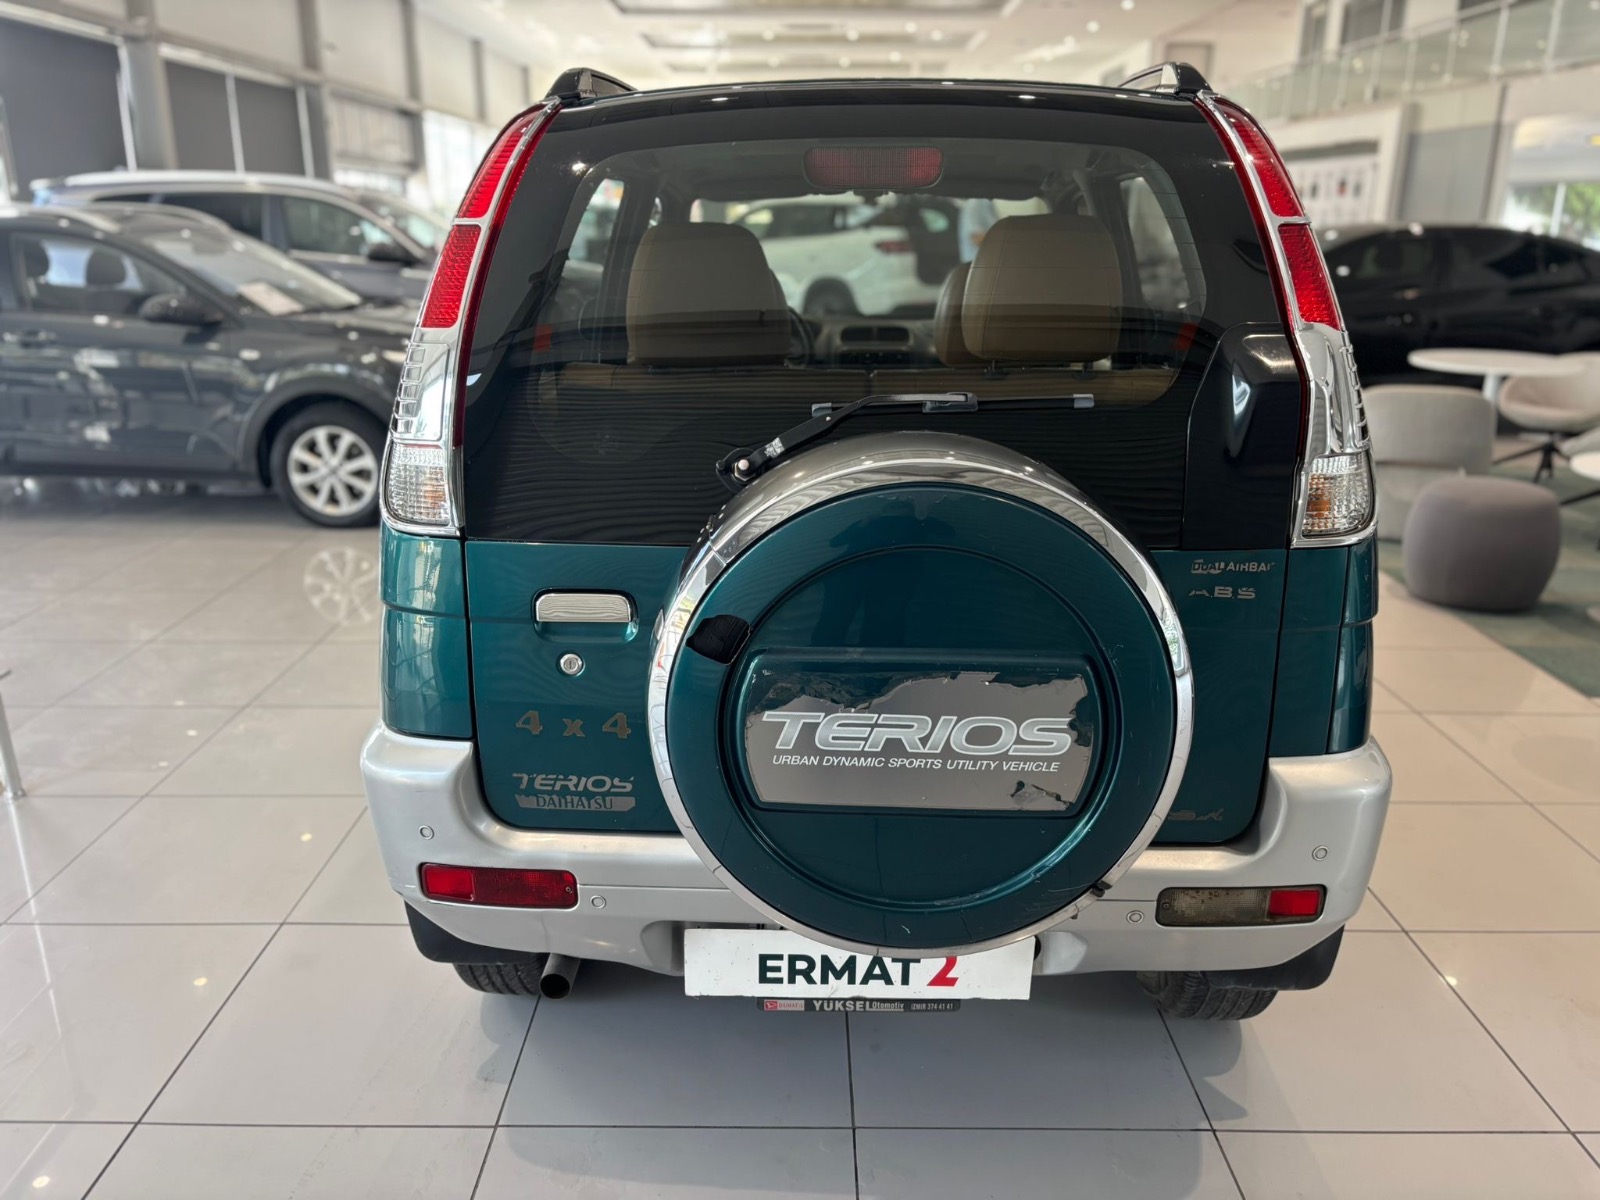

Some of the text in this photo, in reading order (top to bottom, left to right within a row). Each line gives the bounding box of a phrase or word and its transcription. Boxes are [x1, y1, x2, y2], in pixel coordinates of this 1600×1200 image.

[762, 711, 1072, 756] TERIOS
[772, 754, 1060, 772] URBAN DYNAMIC SPORTS UTILITY VEHICLE
[512, 772, 634, 793] TERIOS
[536, 795, 613, 810] DAIHATSU
[813, 1000, 871, 1012] YÜKSEL
[872, 1001, 904, 1010] Otomotiv
